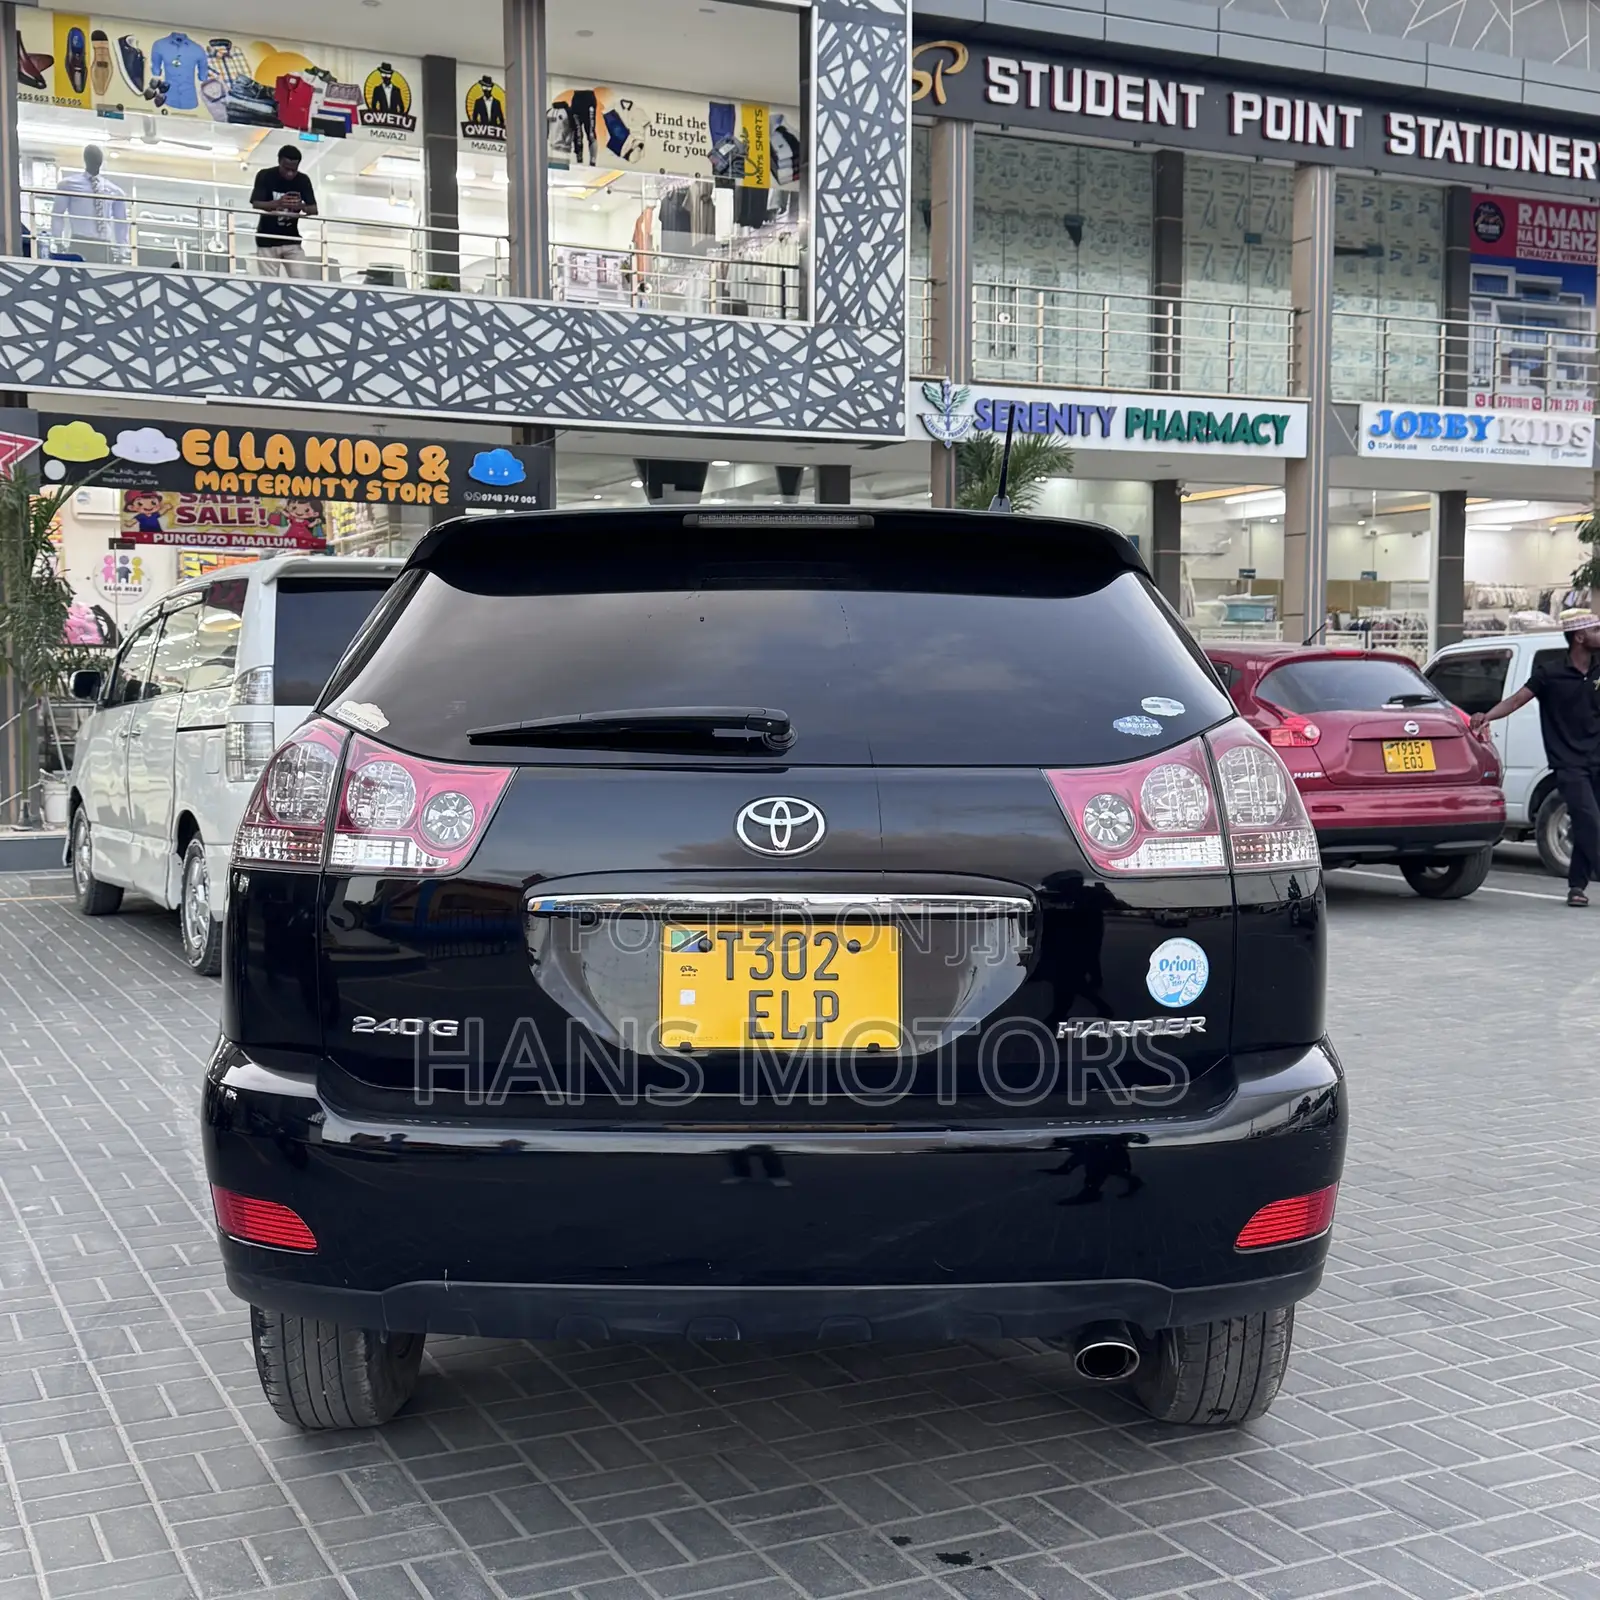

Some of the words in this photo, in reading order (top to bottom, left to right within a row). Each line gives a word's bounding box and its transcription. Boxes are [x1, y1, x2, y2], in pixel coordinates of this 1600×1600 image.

[363, 112, 413, 128] QWETU
[655, 112, 683, 127] Find
[687, 115, 707, 130] the
[755, 108, 764, 151] SHIRTS
[985, 56, 1205, 128] STUDENT
[1230, 91, 1362, 149] POINT
[1385, 112, 1600, 180] STATIONER
[369, 129, 407, 141] MAVAZI
[650, 125, 674, 139] best
[678, 129, 707, 144] style
[471, 141, 506, 152] MAVAZ
[663, 140, 682, 153] for
[684, 146, 707, 158] you
[973, 399, 1118, 438] SERENITY
[1125, 407, 1291, 445] PHARMACY
[1369, 410, 1495, 442] JOBBY
[1498, 416, 1592, 448] KIDS
[181, 429, 296, 471] ELLA
[305, 437, 409, 481] KIDS
[418, 445, 450, 483] &
[194, 471, 359, 499] MATERNITY
[366, 480, 450, 504] STORE
[176, 506, 269, 526] SALE!
[153, 534, 228, 545] PUNGUZO
[232, 535, 298, 547] MAALUM
[717, 930, 839, 981] T302
[748, 990, 840, 1039] ELP
[1056, 1016, 1206, 1039] HARRIER
